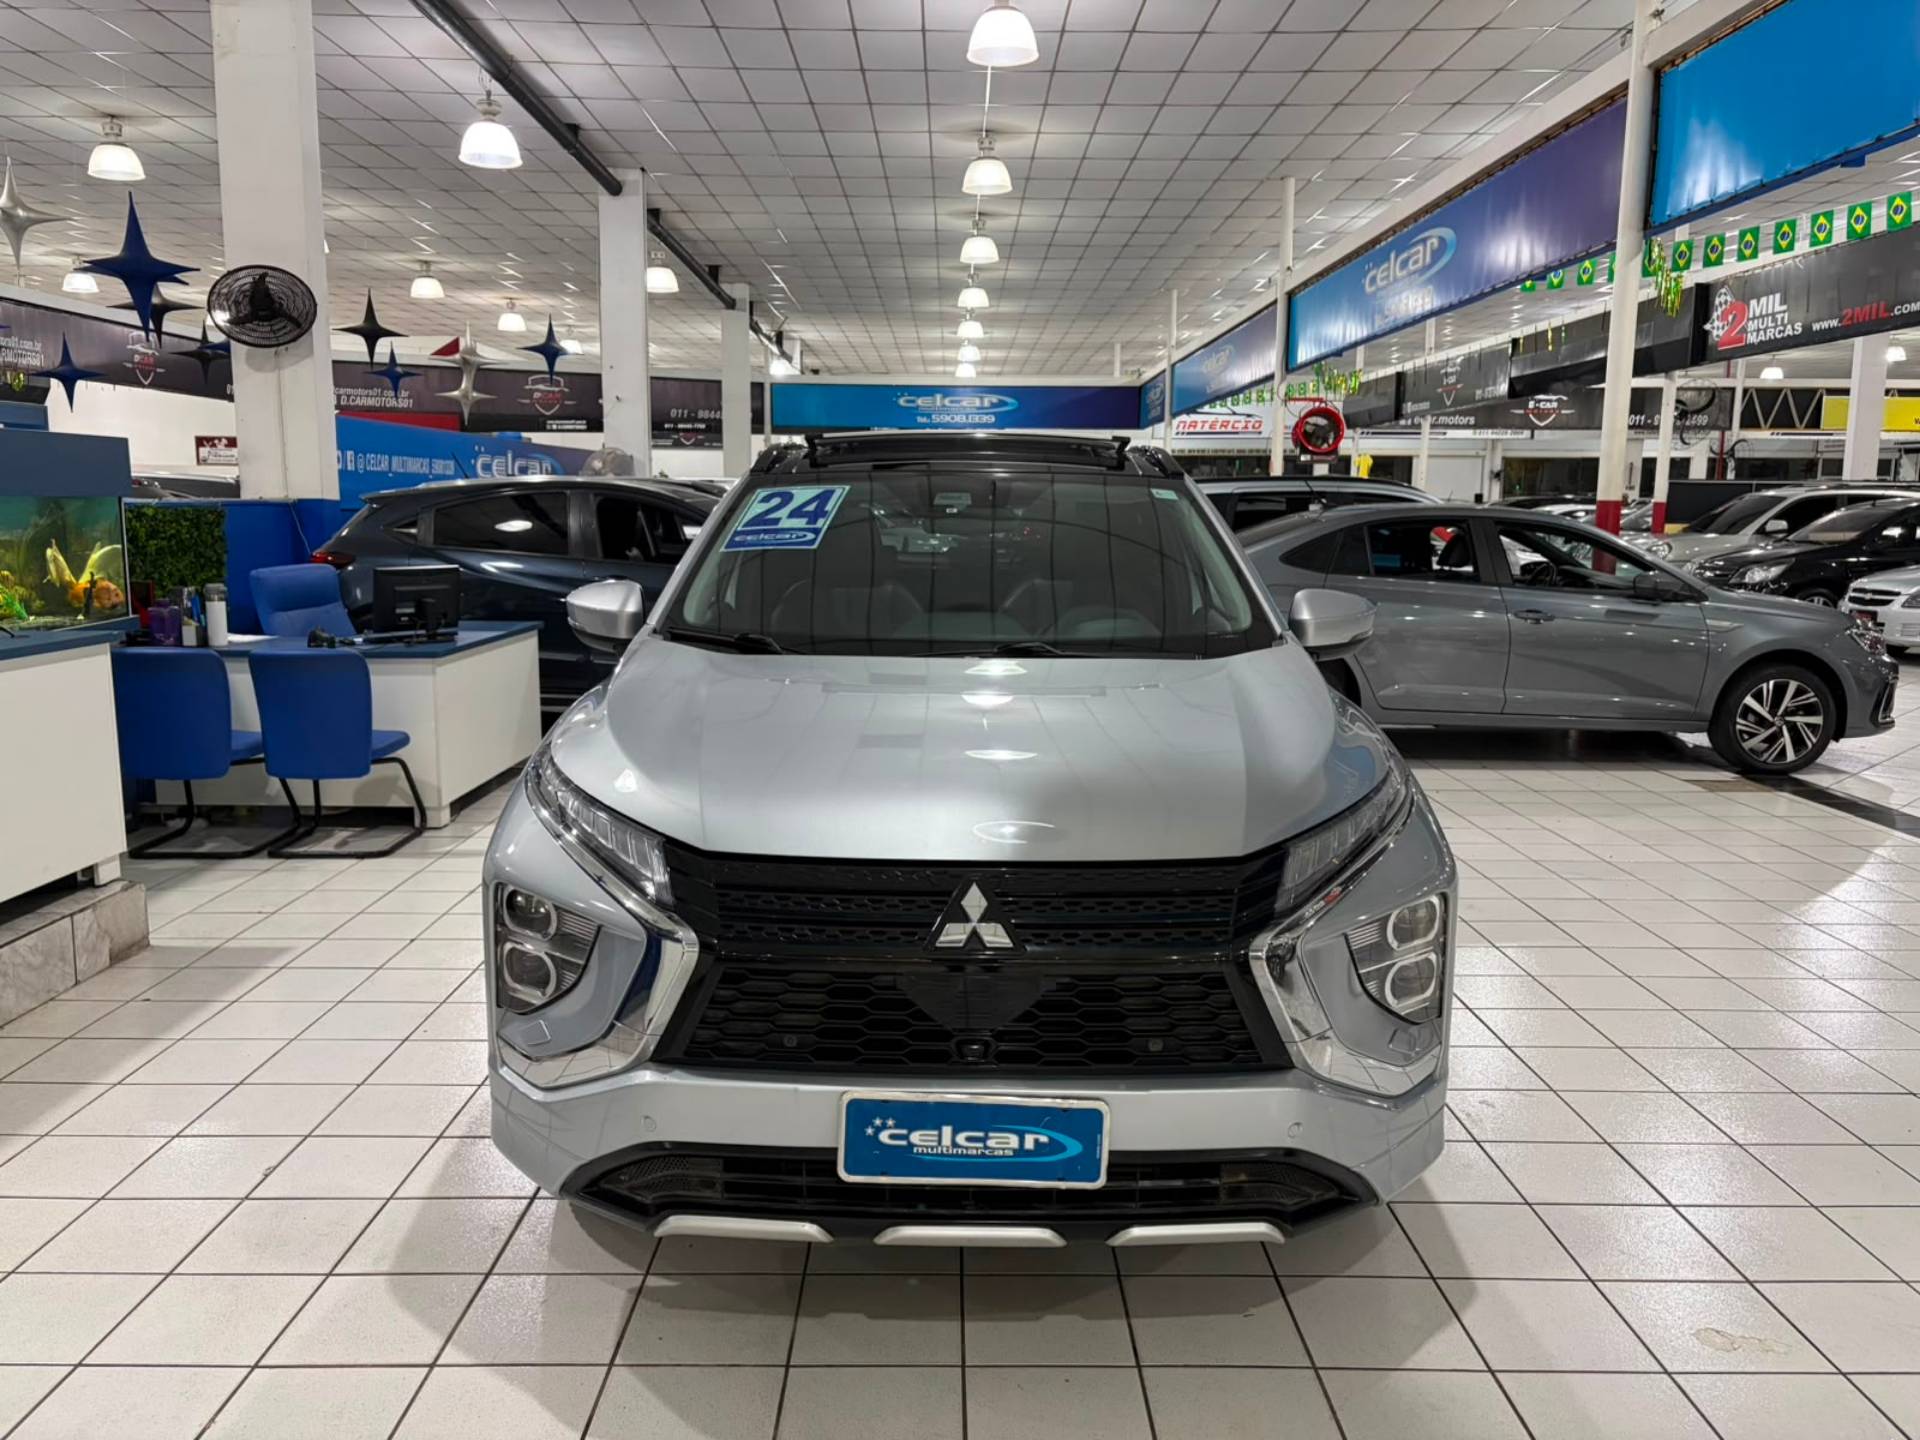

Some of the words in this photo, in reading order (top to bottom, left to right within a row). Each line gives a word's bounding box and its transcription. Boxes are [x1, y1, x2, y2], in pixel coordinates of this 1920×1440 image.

[1364, 238, 1439, 294] celcar
[1749, 293, 1788, 318] MIL
[1718, 300, 1748, 350] 2
[1747, 322, 1803, 344] MARCAS
[1748, 312, 1789, 331] MULTI
[897, 393, 999, 408] celcar
[1175, 417, 1263, 431] NATÉRCIO
[475, 450, 551, 479] celcar
[741, 489, 836, 527] 24
[878, 1125, 1049, 1150] celcar
[913, 1145, 1014, 1157] multimarcas
